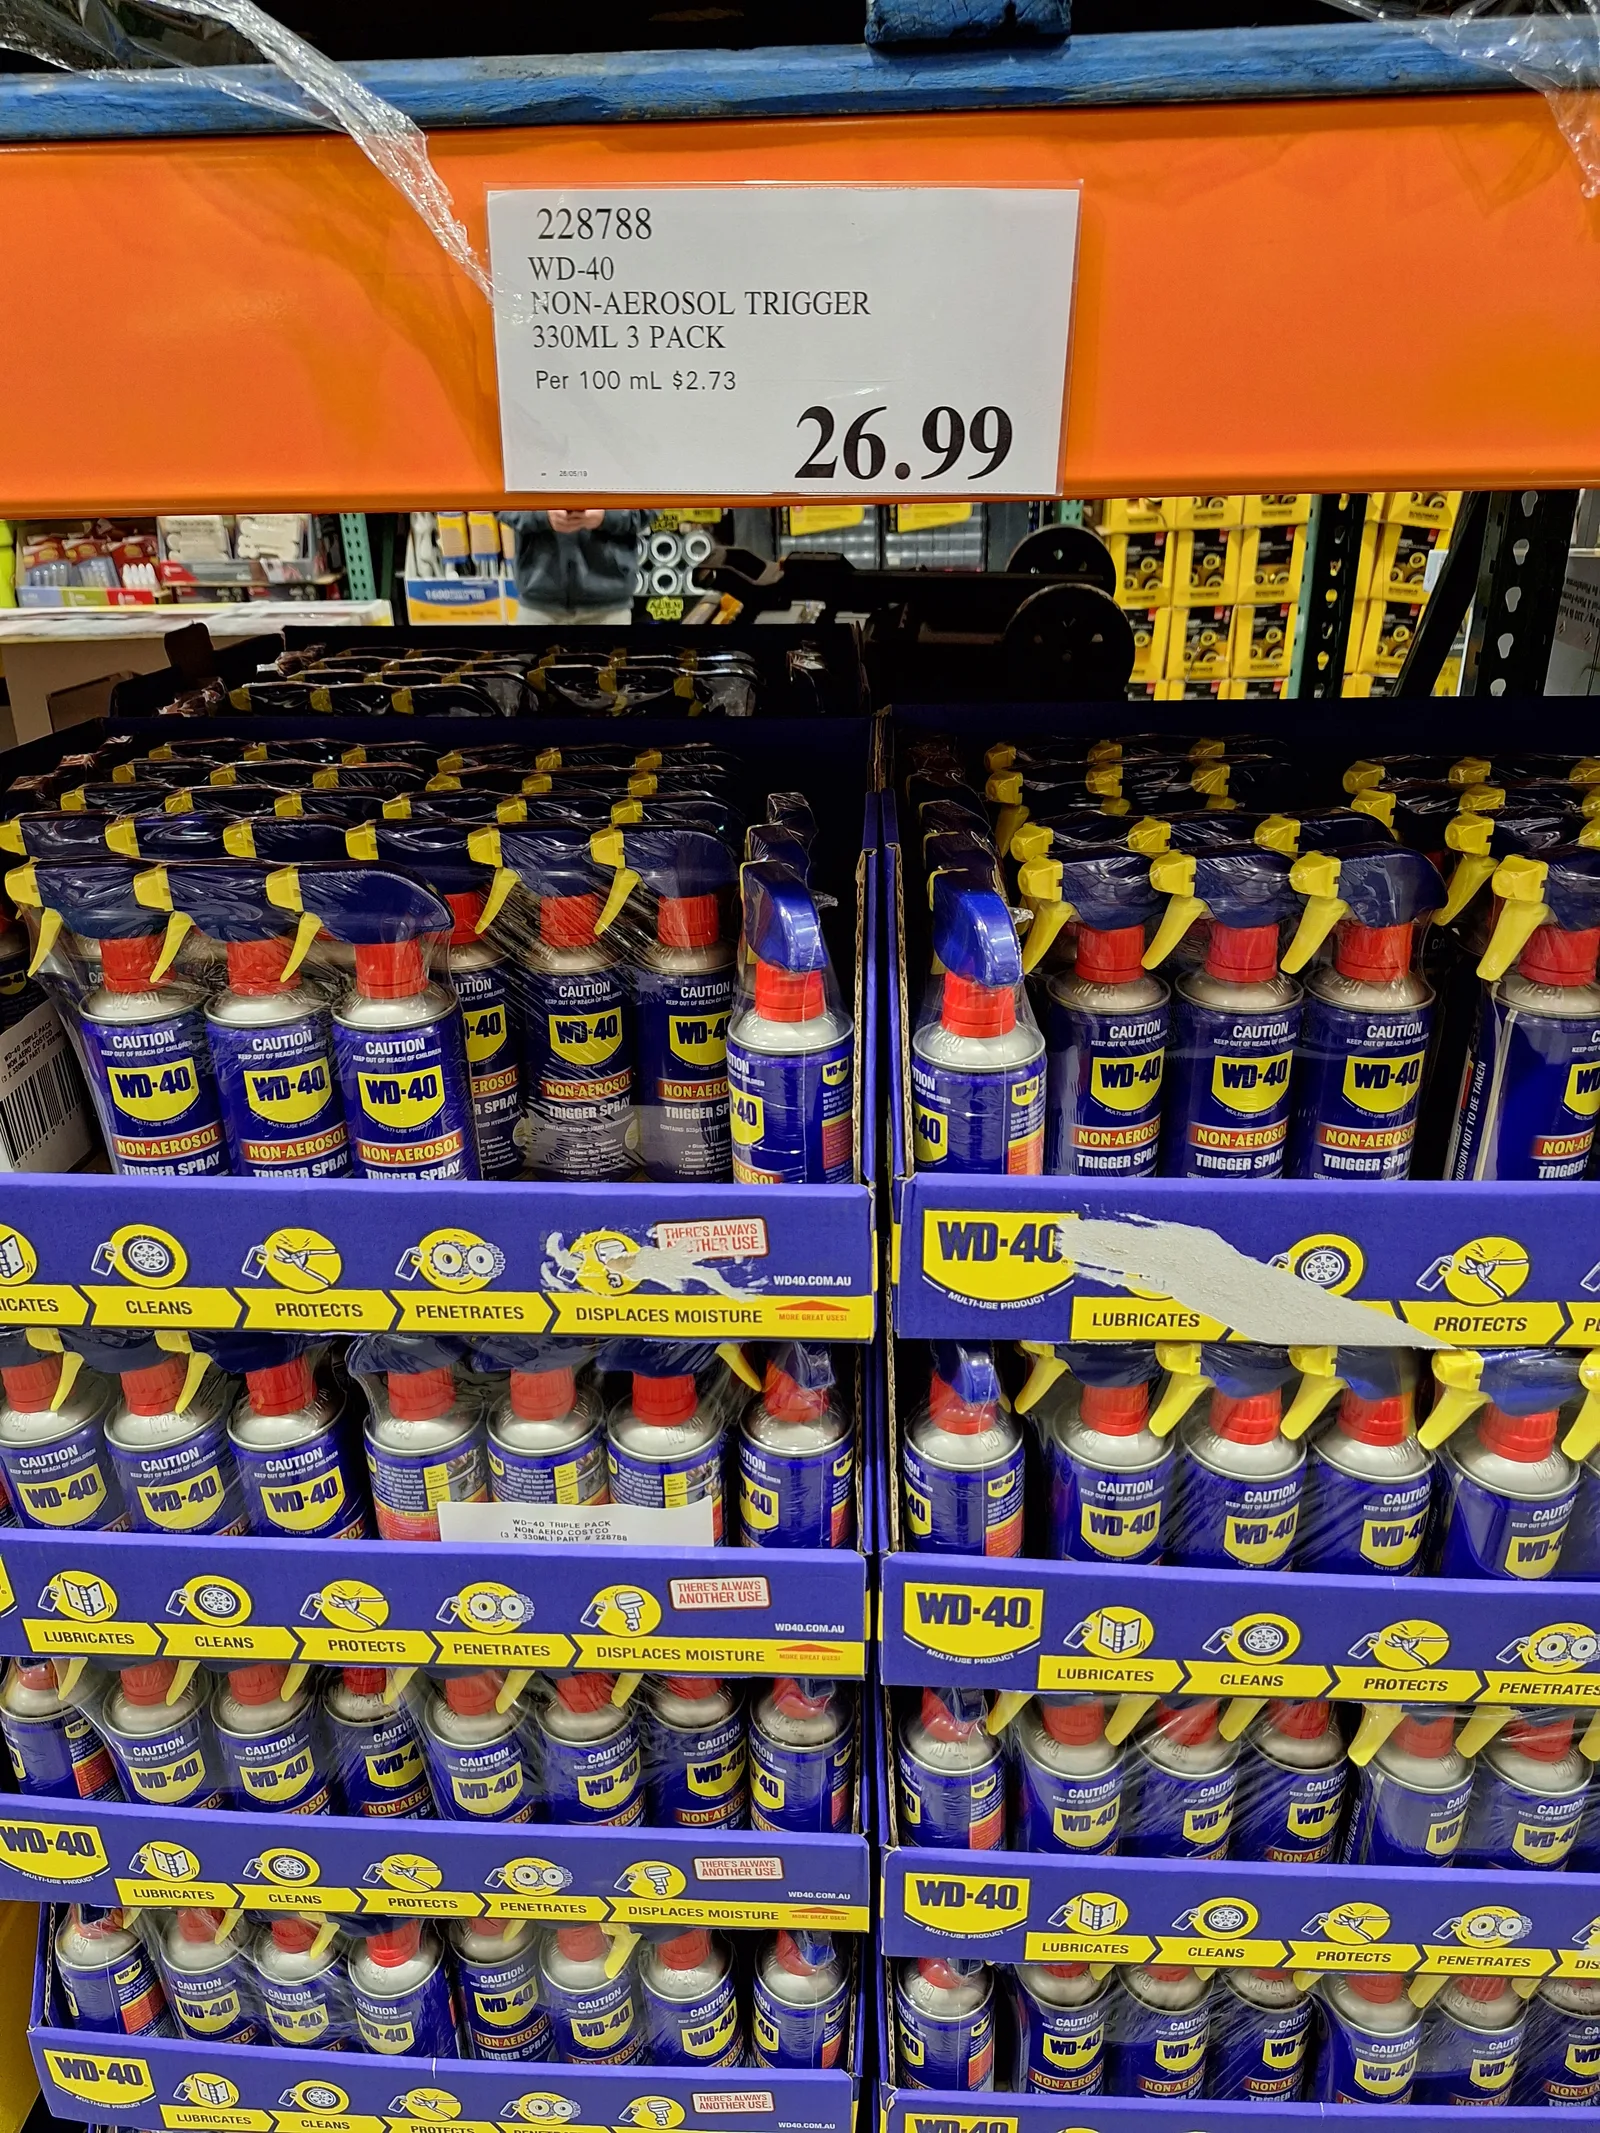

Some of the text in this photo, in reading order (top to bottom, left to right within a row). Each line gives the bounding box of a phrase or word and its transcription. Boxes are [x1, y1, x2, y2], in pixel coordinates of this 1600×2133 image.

[536, 208, 653, 241] 228788
[528, 257, 615, 281] WD-40
[529, 290, 872, 316] NON-AEROSOL TRIGGER
[532, 325, 726, 350] 330ML 3 PACK
[535, 370, 737, 392] Per 100 mL $2.73
[793, 404, 1013, 482] 26.99
[559, 981, 611, 998] CAUTION
[680, 981, 730, 999] CAUTION
[555, 1013, 618, 1044] WD-40
[1110, 1019, 1161, 1039] CAUTION
[1232, 1021, 1289, 1039] CAUTION
[1367, 1021, 1422, 1038] CAUTION
[112, 1029, 175, 1049] CAUTION
[252, 1030, 312, 1051] CAUTION
[366, 1038, 425, 1054] CAUTION
[135, 1049, 154, 1057] REACH
[156, 1047, 164, 1055] OF
[1100, 1055, 1161, 1089] WD-40
[1222, 1059, 1288, 1089] WD-40
[1353, 1059, 1418, 1089] WD-40
[1473, 1061, 1486, 1095] TAKEN
[115, 1066, 192, 1099] WD-40
[252, 1065, 327, 1102] WD-40
[364, 1074, 437, 1105] WD-40
[546, 1074, 631, 1097] NON-AEROSOL
[549, 1094, 631, 1119] TRIGGER SPRAY
[1470, 1096, 1480, 1112] BE
[665, 1106, 713, 1120] TRIGGER
[1467, 1112, 1476, 1126] TO
[117, 1128, 218, 1156] NON-AEROSOL
[249, 1130, 346, 1160] NON-AEROSOL
[1463, 1126, 1474, 1149] NOT
[362, 1136, 459, 1162] NON-AEROSOL
[1195, 1146, 1285, 1171] TRIGGER SPRAY
[937, 1221, 1064, 1263] WD-40
[773, 1275, 852, 1287] WD40.COM.AU
[0, 1298, 59, 1312] ICATES
[126, 1300, 193, 1315] CLEANS
[276, 1302, 363, 1317] PROTECTS
[948, 1292, 1046, 1310] MULTI-USE PRODUCT
[416, 1305, 524, 1320] PENETRATES
[576, 1307, 763, 1324] DISPLACES MOISTURE
[779, 1313, 799, 1321] MORE
[1092, 1313, 1200, 1328] LUBRICATES
[1433, 1317, 1527, 1332] PROTECTS
[19, 1444, 79, 1469] CAUTION
[141, 1447, 200, 1472] CAUTION
[265, 1448, 324, 1473] CAUTION
[24, 1473, 98, 1509] WD-40
[145, 1475, 217, 1513] WD-40
[267, 1475, 339, 1513] WD-40
[1097, 1479, 1154, 1495] CAUTION
[1244, 1482, 1297, 1503] CAUTION
[512, 1518, 612, 1529] WD-40 TRIPLE PACK
[514, 1526, 609, 1536] NON AERO COSTCO
[1089, 1511, 1156, 1537] WD-40
[1234, 1513, 1294, 1545] WD-40
[500, 1532, 509, 1540] (3
[523, 1533, 554, 1542] 330ML)
[677, 1580, 761, 1592] THERE'S ALWAYS
[678, 1592, 736, 1604] ANOTHER
[916, 1591, 1032, 1628] WD-40
[774, 1623, 845, 1634] WD40.COM.AU
[43, 1630, 135, 1645] LUBRICATES
[194, 1636, 254, 1649] CLEANS
[328, 1639, 406, 1653] PROTECTS
[453, 1643, 550, 1656] PENETRATES
[596, 1646, 765, 1662] DISPLACES MOISTURE
[779, 1653, 798, 1661] MORE
[926, 1649, 1015, 1665] MULTI-USE PRODUCT
[1057, 1668, 1154, 1682] LUBRICATES
[1219, 1674, 1284, 1687] CLEANS
[1363, 1677, 1448, 1691] PROTECTS
[459, 1747, 510, 1767] CAUTION
[135, 1760, 199, 1789] WD-40
[247, 1755, 308, 1788] WD-40
[584, 1756, 637, 1797] WD-40
[458, 1769, 519, 1800] WD-40
[1060, 1802, 1116, 1832] WD-40
[700, 1860, 738, 1868] THERE'S
[701, 1867, 752, 1877] ANOTHER
[21, 1871, 94, 1885] MULTI-USE PRODUCT
[132, 1888, 215, 1901] LUBRICATES
[268, 1893, 322, 1904] CLEANS
[388, 1897, 458, 1909] PROTECTS
[788, 1891, 851, 1900] WD40.COM.AU
[915, 1879, 1020, 1911] WD-40
[500, 1902, 587, 1914] PENETRATES
[628, 1906, 779, 1920] DISPLACES MOISTURE
[925, 1926, 1004, 1940] MULTI-USE PRODUCT
[1041, 1942, 1129, 1955] LUBRICATES
[1188, 1946, 1245, 1958] CLEANS
[1316, 1950, 1392, 1963] PROTECTS
[1436, 1955, 1531, 1968] PENETRATES
[480, 1964, 525, 1985] CAUTION
[479, 1983, 534, 2014] WD-40
[54, 2056, 144, 2086] WD-40
[698, 2093, 767, 2103] THERE'S ALWAYS
[699, 2101, 746, 2112] ANOTHER
[176, 2114, 251, 2126] LUBRICATES
[301, 2120, 350, 2130] CLEANS
[777, 2121, 836, 2130] WD40.COM.AU
